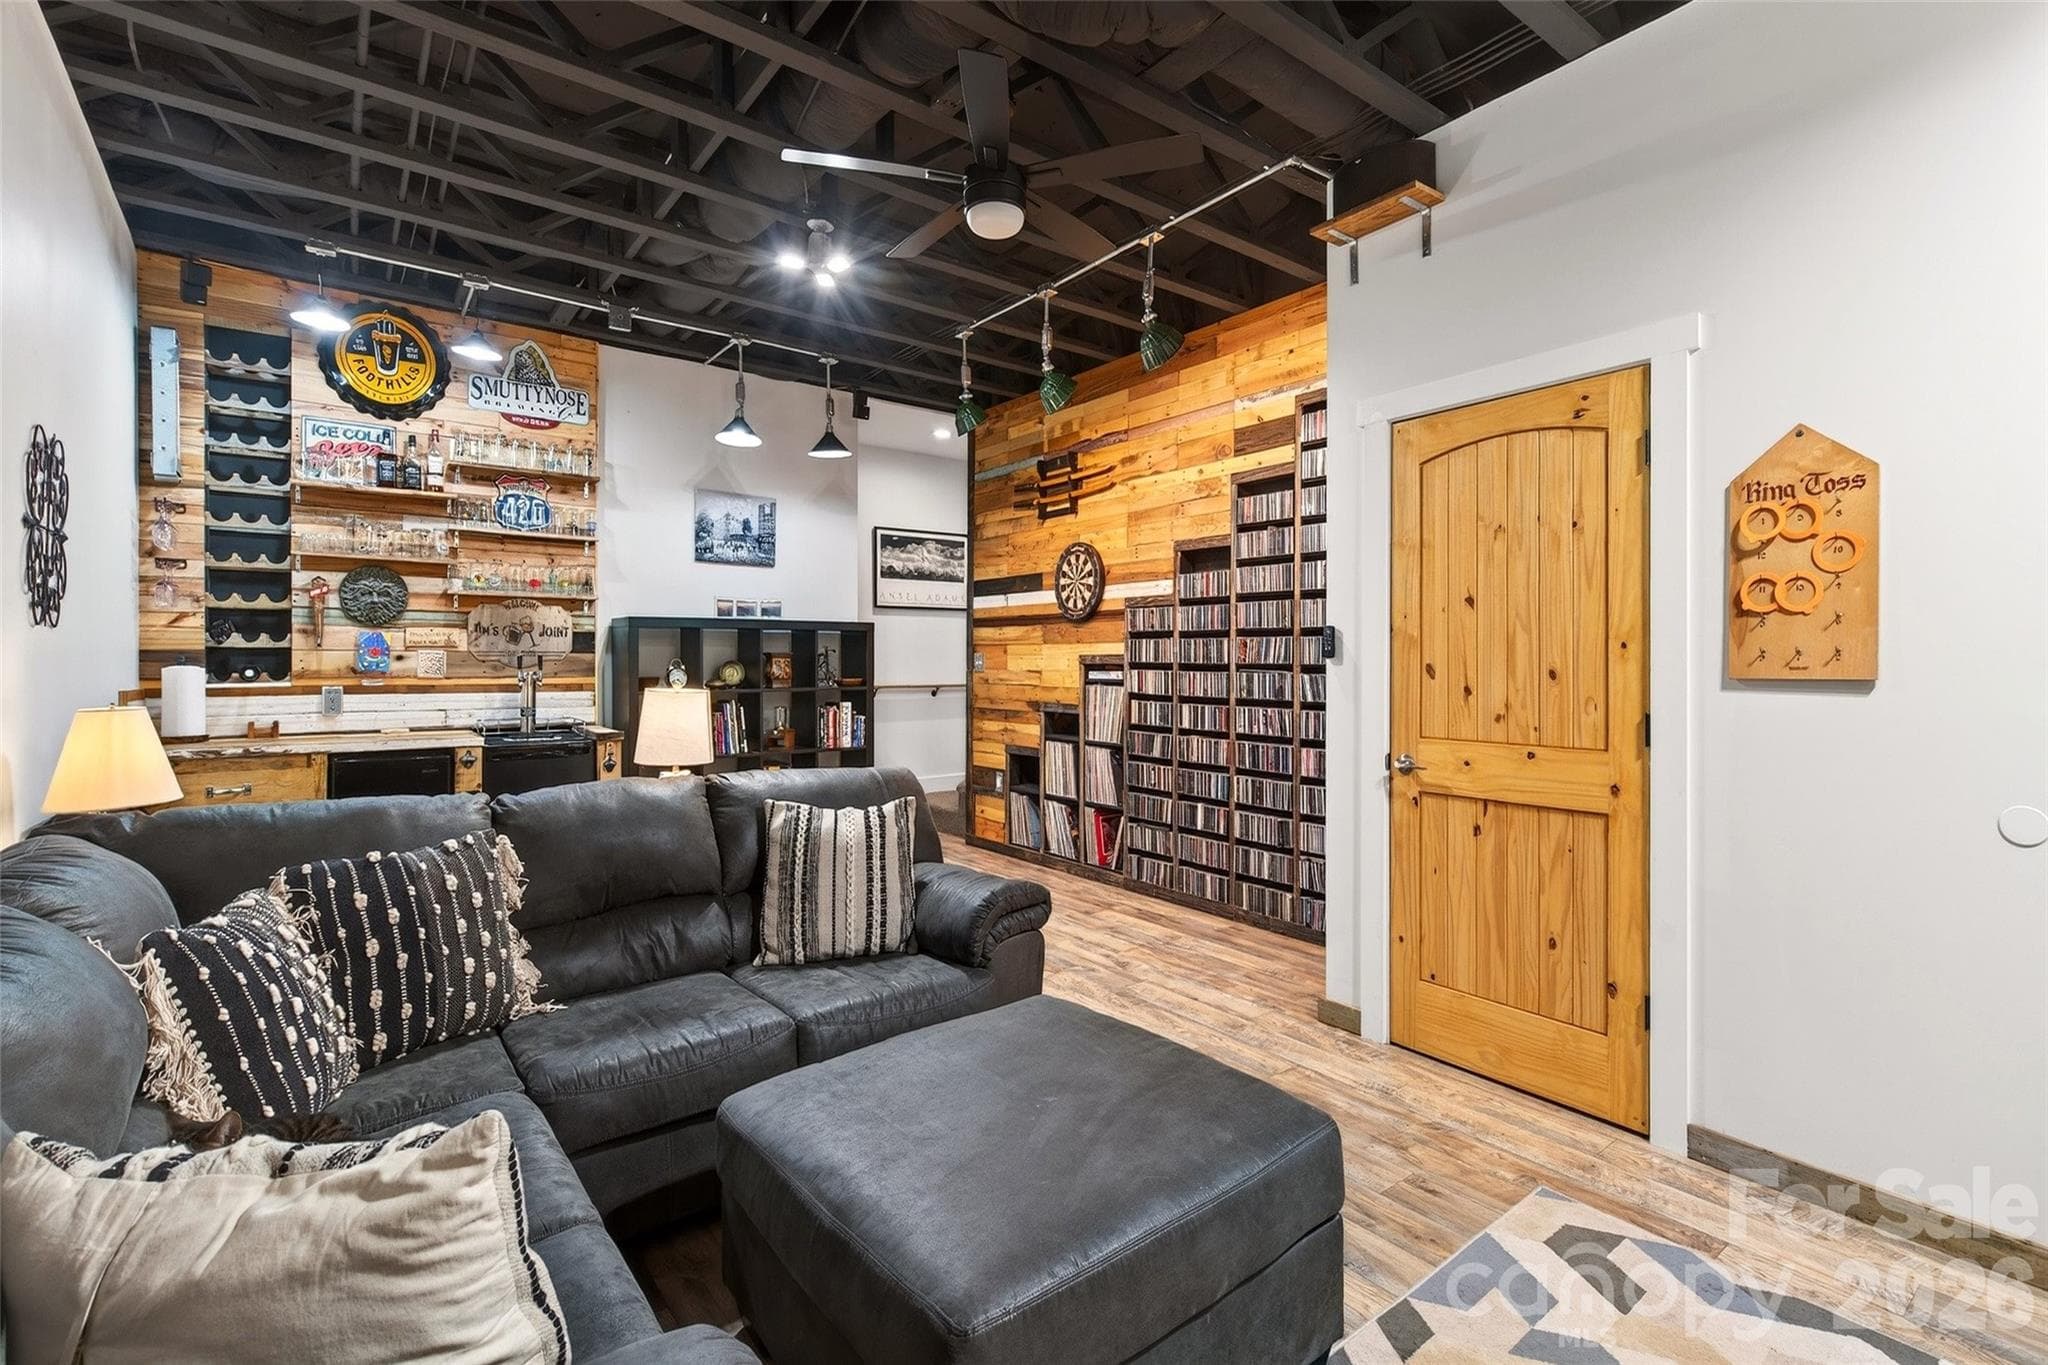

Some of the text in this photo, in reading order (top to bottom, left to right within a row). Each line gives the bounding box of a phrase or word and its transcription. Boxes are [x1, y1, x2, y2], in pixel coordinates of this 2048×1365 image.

[353, 358, 420, 390] FOOTHILLS
[470, 376, 587, 416] SMUTTYNOSE
[312, 424, 340, 438] ICE
[1800, 471, 1867, 496] Toss
[880, 592, 917, 601] ANSEL
[539, 624, 569, 638] JOINT
